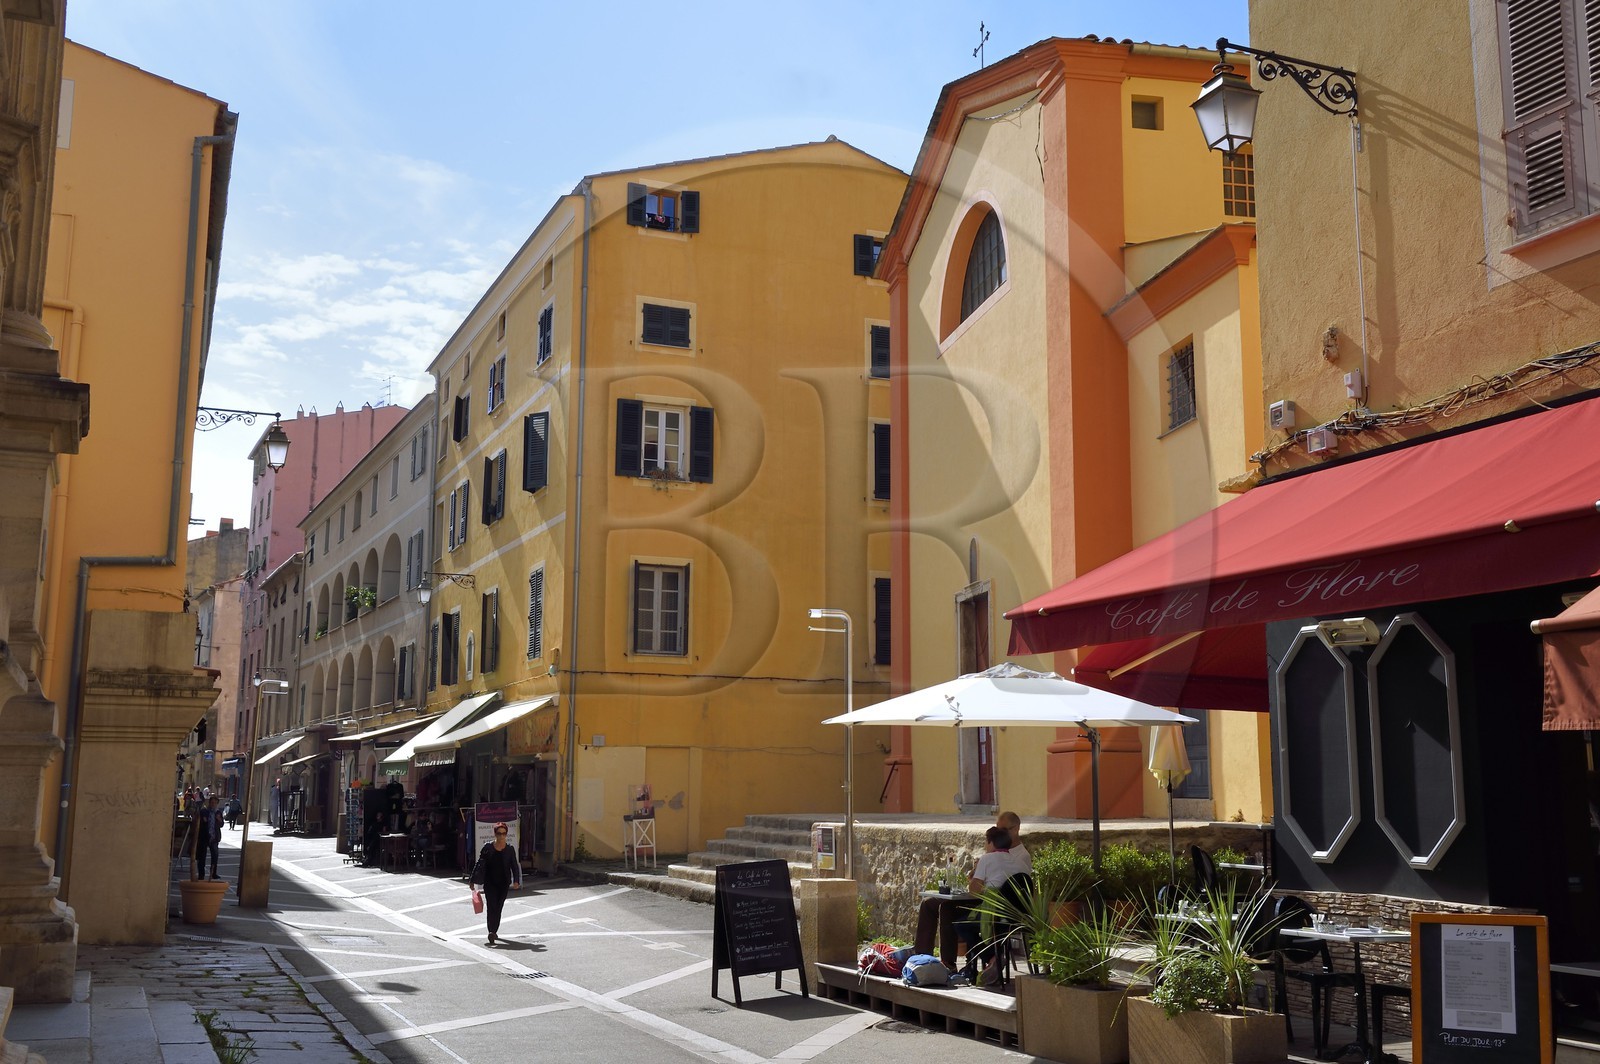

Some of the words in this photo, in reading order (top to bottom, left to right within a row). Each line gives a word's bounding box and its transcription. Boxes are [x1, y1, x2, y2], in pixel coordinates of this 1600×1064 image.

[1105, 588, 1199, 634] Café
[1209, 580, 1259, 614] de
[1277, 559, 1419, 607] Flore
[1460, 1036, 1471, 1045] DU
